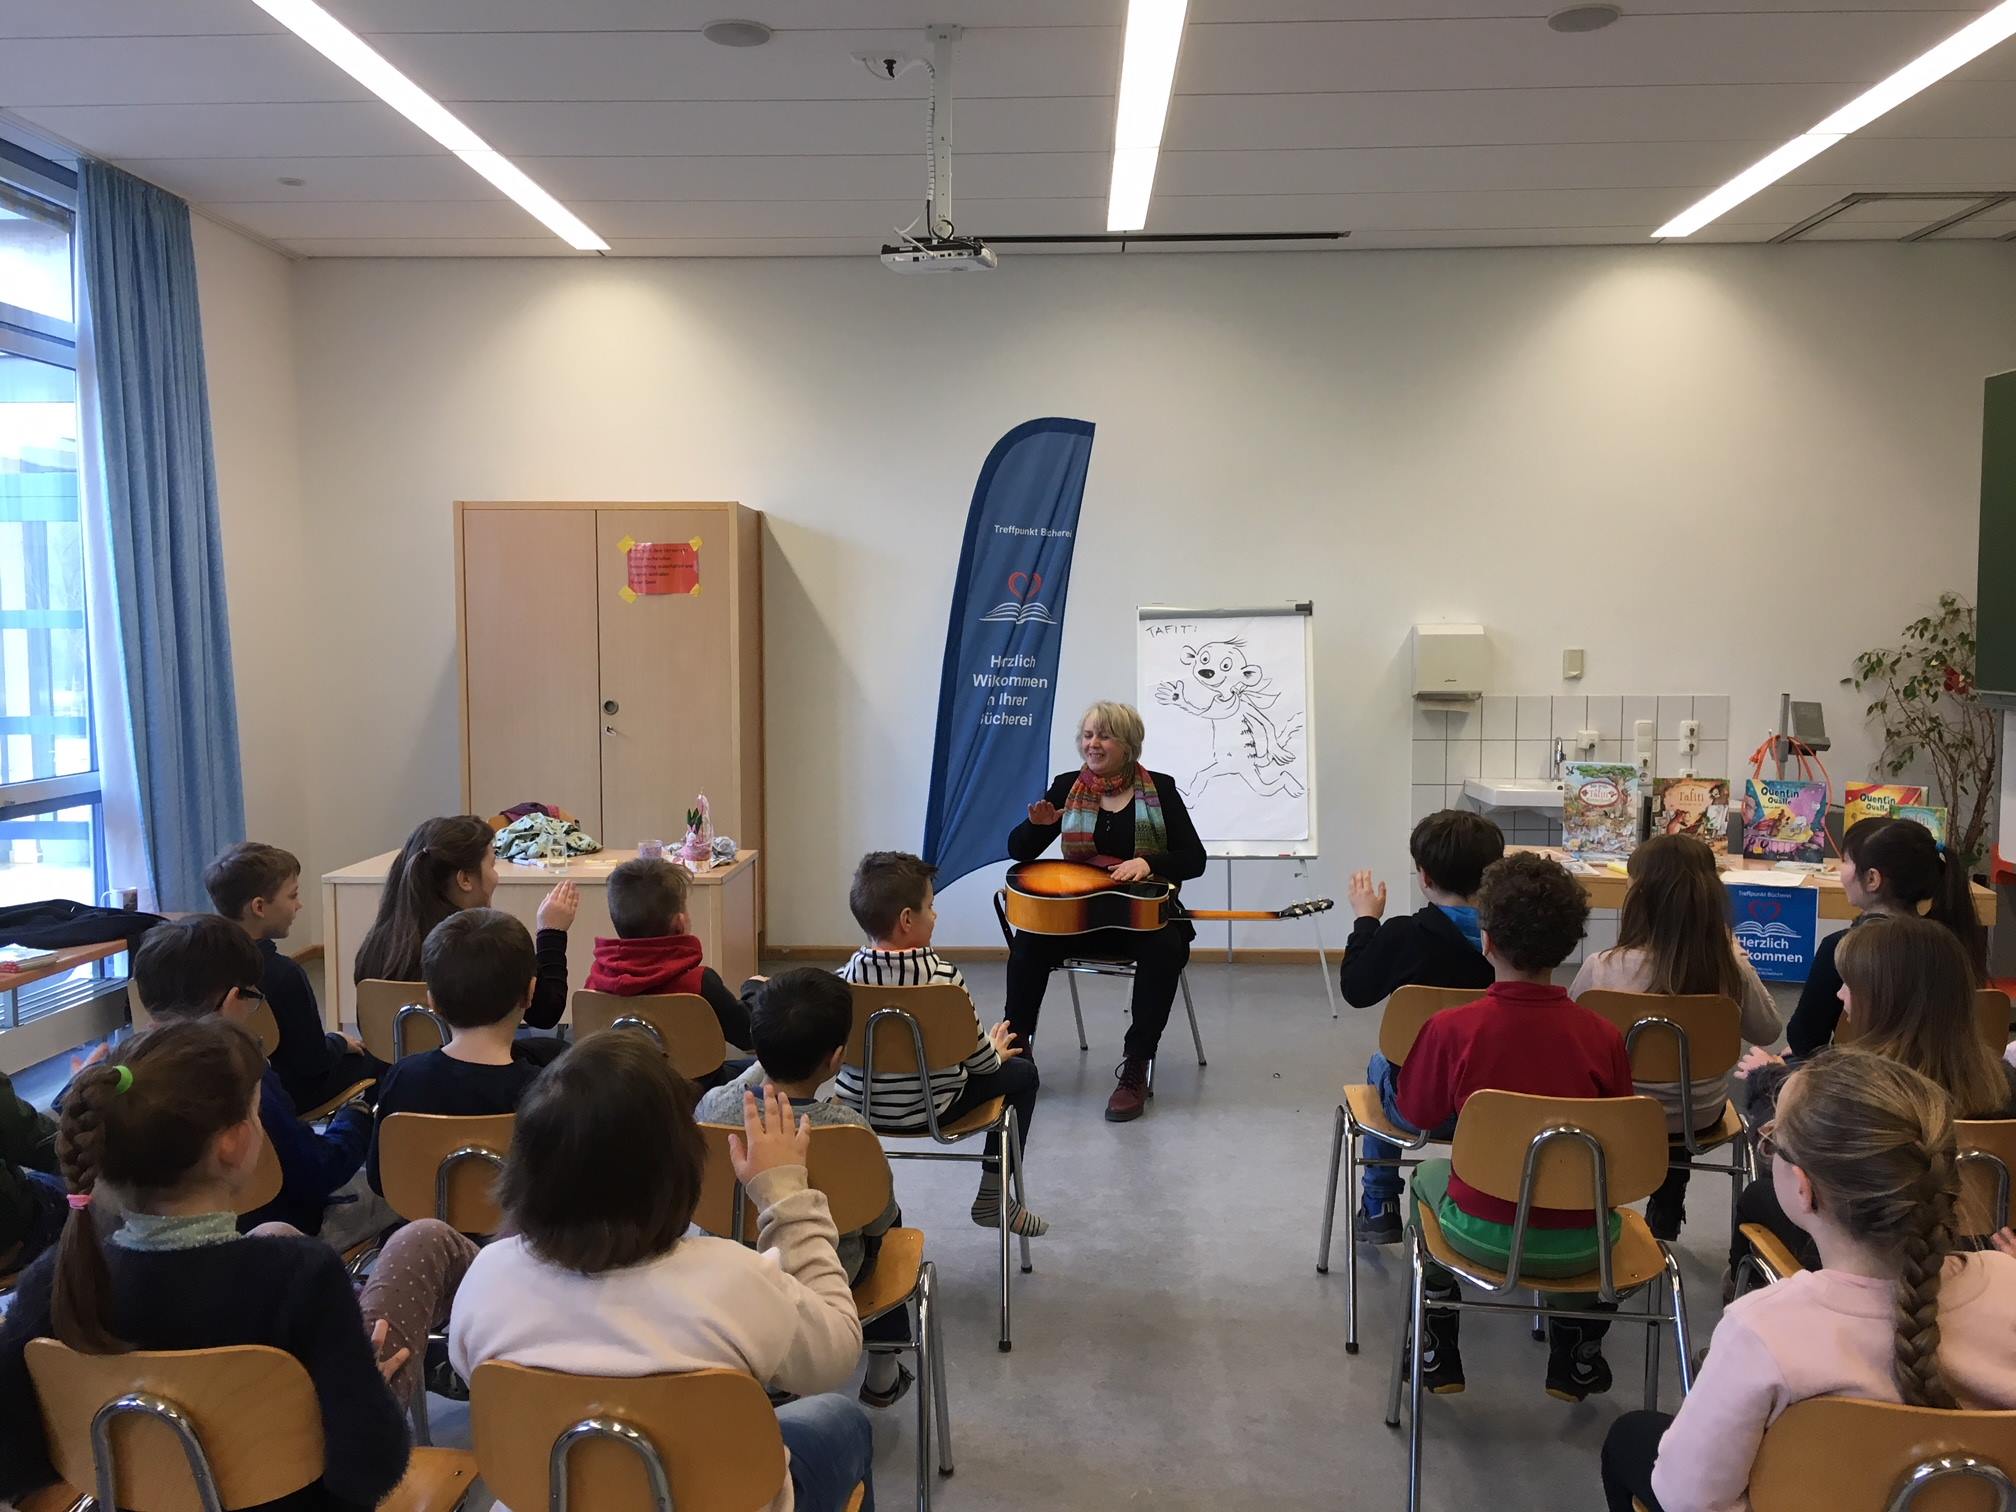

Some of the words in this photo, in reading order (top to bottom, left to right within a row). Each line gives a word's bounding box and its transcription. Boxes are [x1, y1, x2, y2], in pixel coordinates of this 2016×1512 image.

[994, 525, 1038, 536] Treffpunkt
[999, 692, 1028, 706] Ihrer
[1761, 786, 1799, 798] Quentin
[1860, 793, 1896, 805] Quentin
